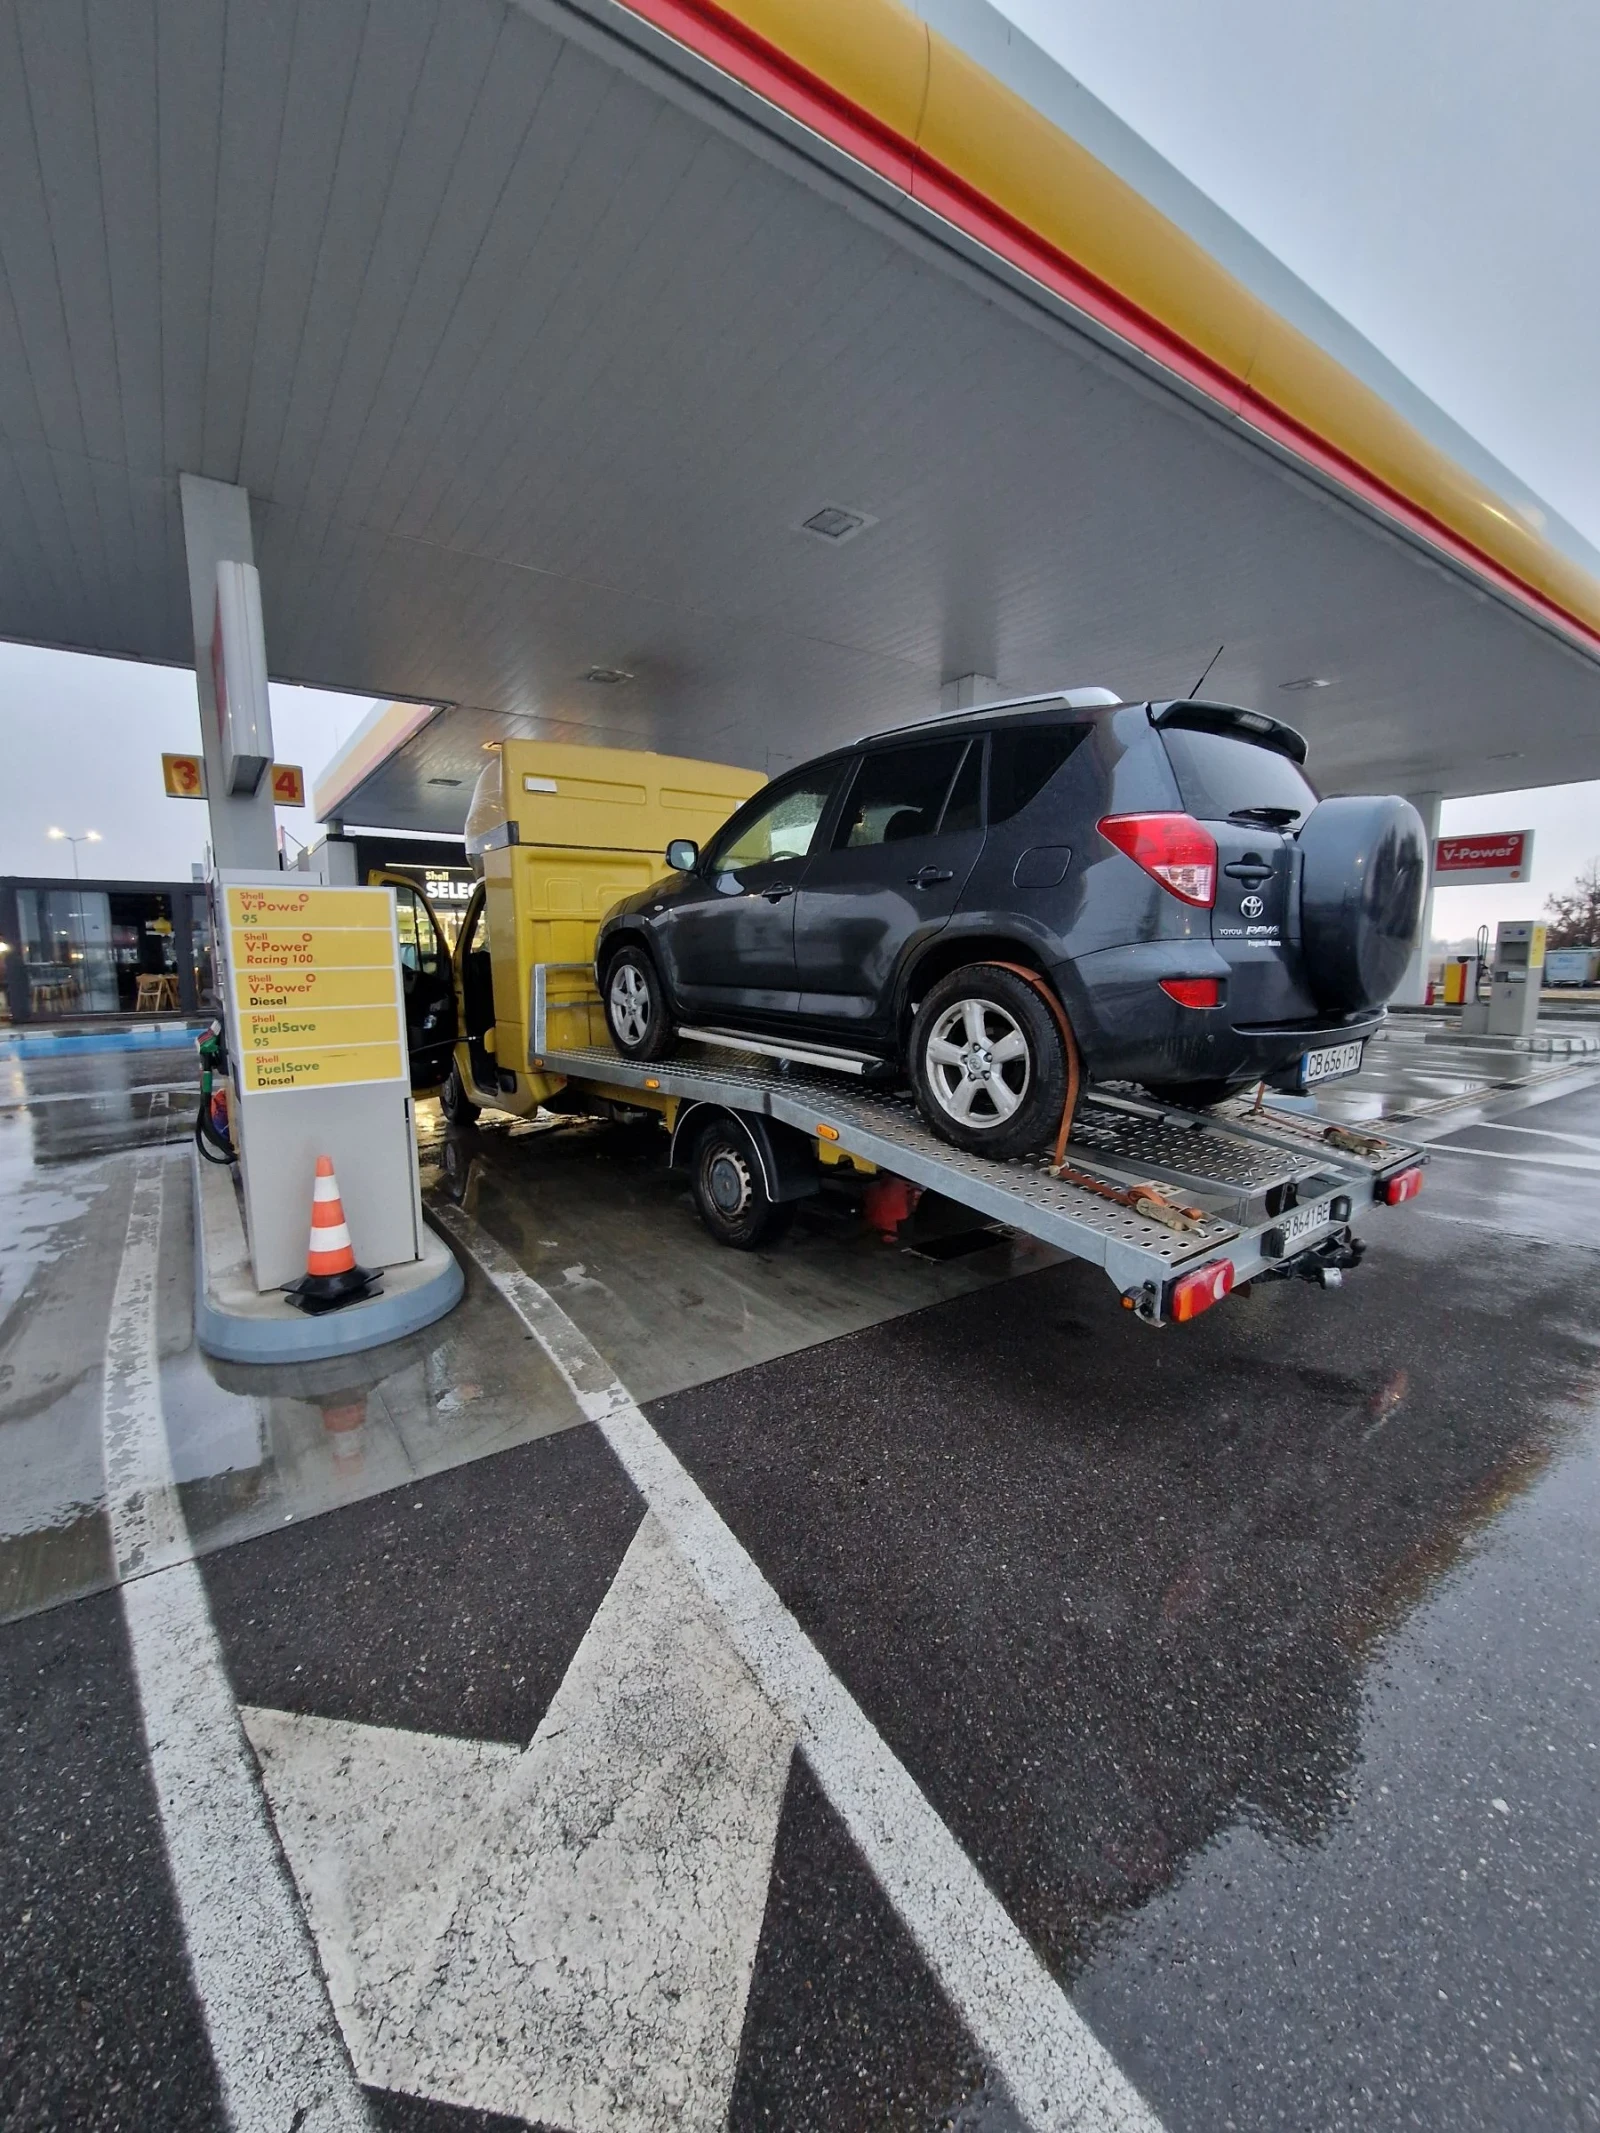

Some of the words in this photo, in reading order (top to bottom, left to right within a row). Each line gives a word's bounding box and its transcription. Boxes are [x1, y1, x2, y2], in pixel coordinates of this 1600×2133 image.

[173, 760, 198, 790] 3
[275, 771, 299, 798] 4
[1443, 847, 1514, 860] V-Power
[425, 871, 449, 881] Shell
[240, 892, 264, 900] Shell
[242, 901, 305, 912] V-Power
[242, 914, 258, 923] 95
[244, 933, 268, 941] Shell
[246, 942, 308, 952] V-Power
[247, 955, 288, 966] Racing
[293, 954, 314, 963] 100
[248, 975, 272, 983] Shell
[250, 983, 312, 994] V-Power
[250, 996, 287, 1006] Diesel
[252, 1014, 275, 1023] Shell
[253, 1022, 316, 1034] FuelSave
[254, 1038, 269, 1047] 95
[256, 1055, 279, 1064] Shell
[257, 1062, 320, 1075] FuelSave
[258, 1075, 295, 1086] Diesel
